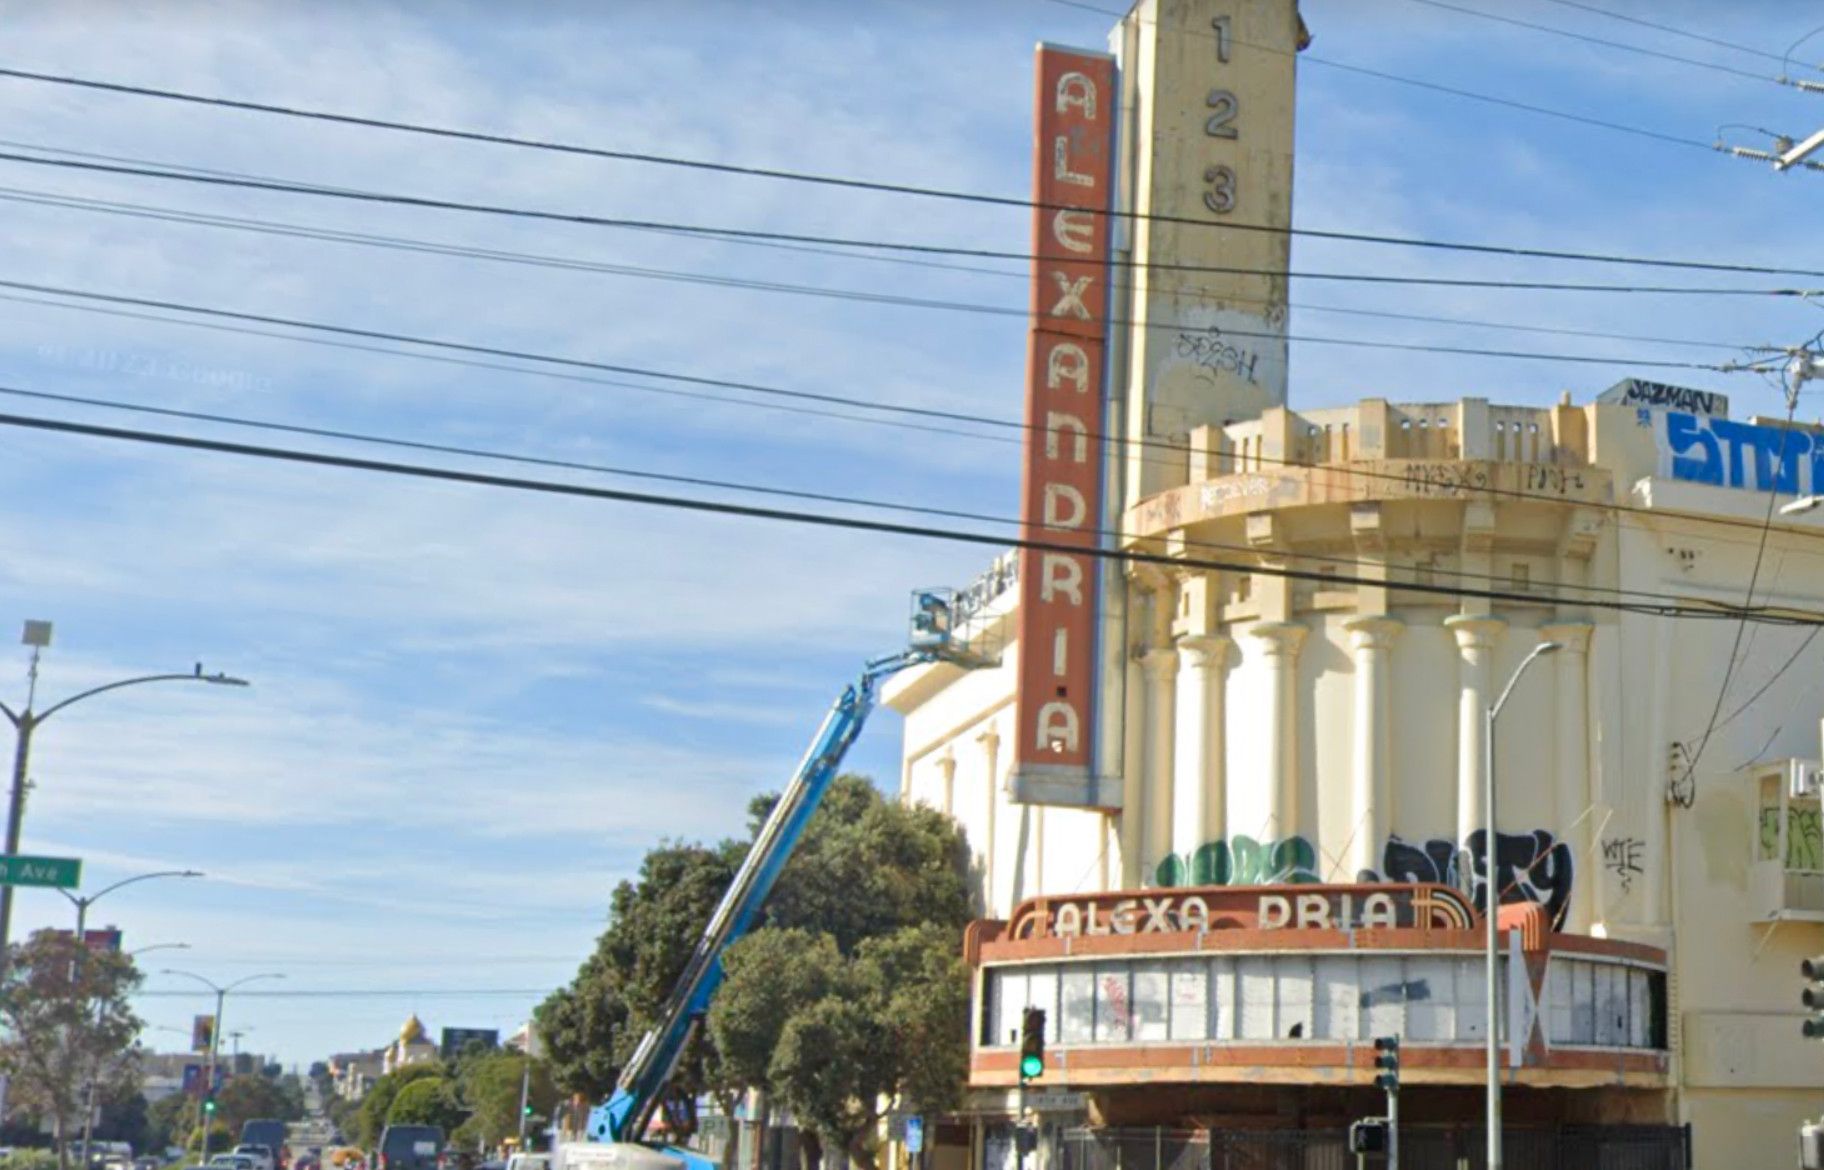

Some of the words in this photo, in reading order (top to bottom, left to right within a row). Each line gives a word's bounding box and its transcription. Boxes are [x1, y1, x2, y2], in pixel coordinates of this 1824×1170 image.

[1036, 71, 1098, 753] ALEXANDRIA
[21, 863, 58, 881] Ave
[1053, 895, 1210, 938] ALEXA
[1258, 892, 1397, 931] DRIA
